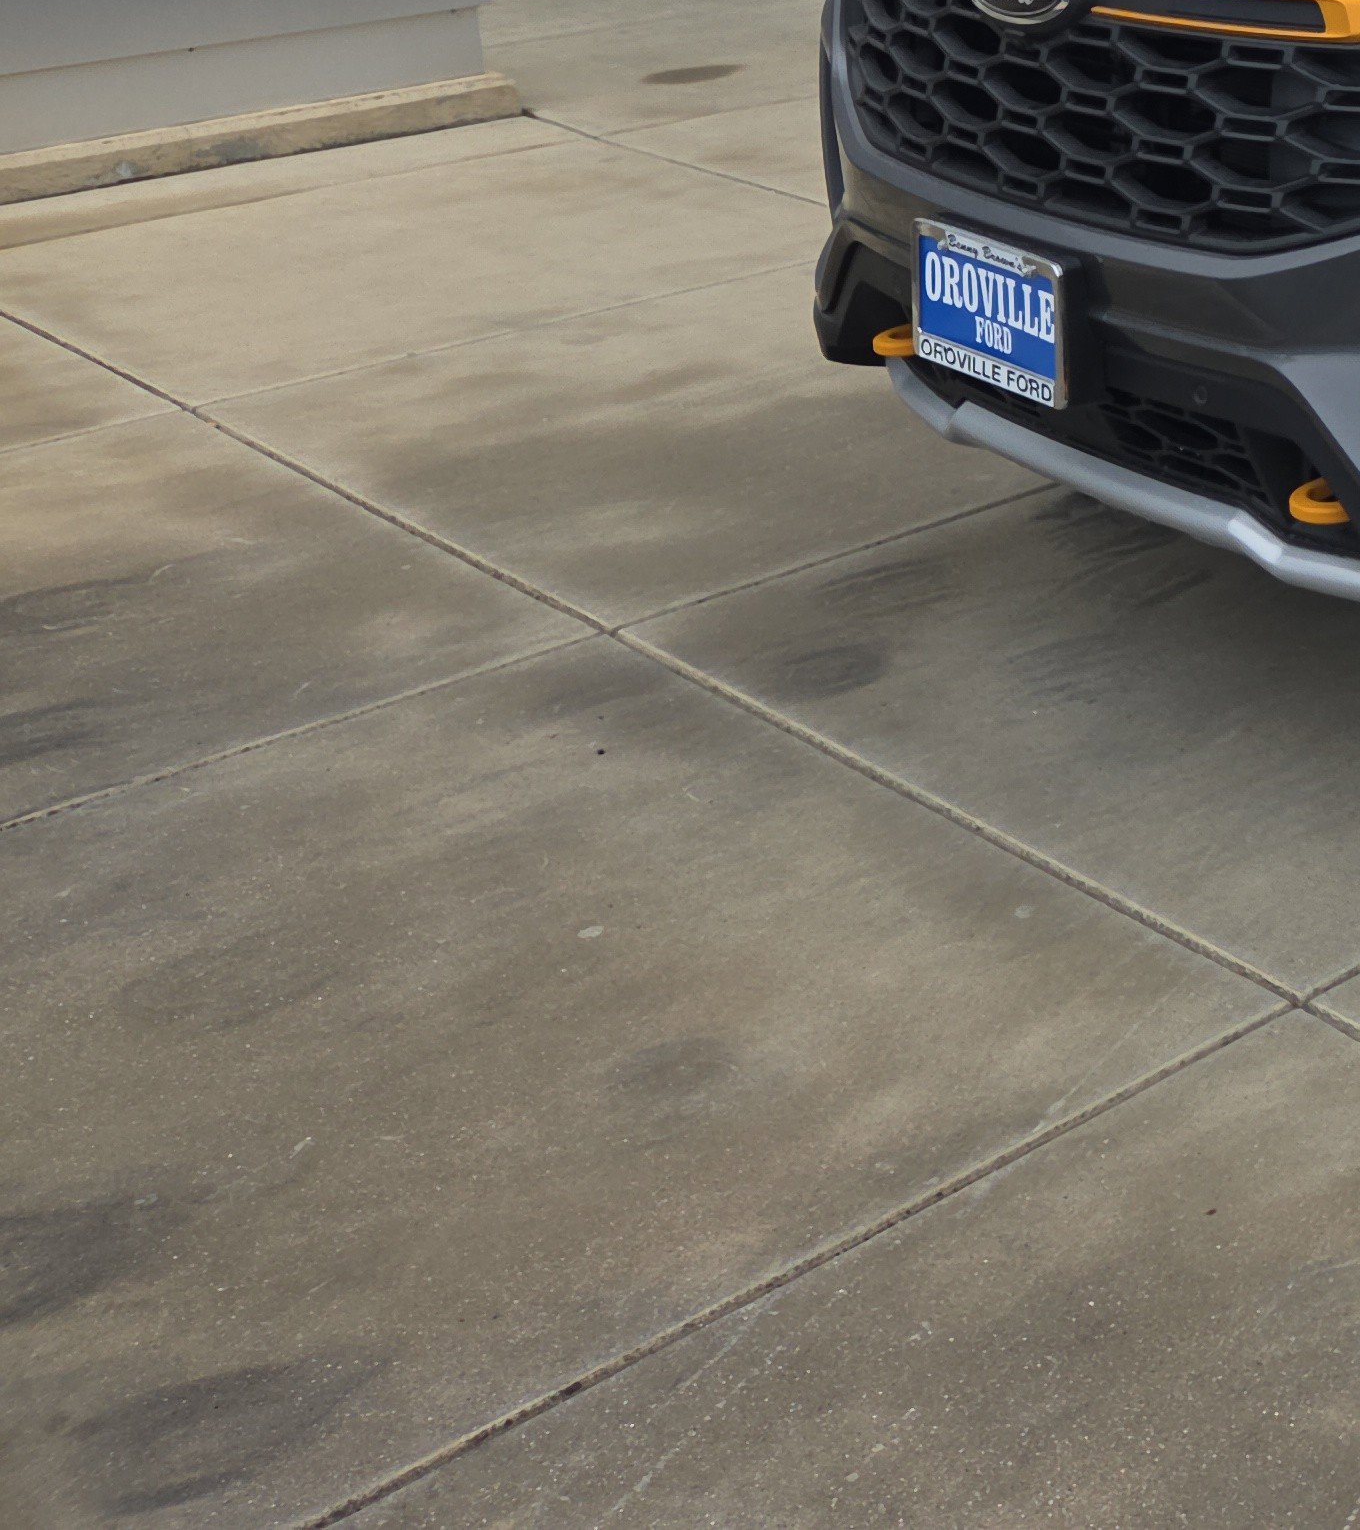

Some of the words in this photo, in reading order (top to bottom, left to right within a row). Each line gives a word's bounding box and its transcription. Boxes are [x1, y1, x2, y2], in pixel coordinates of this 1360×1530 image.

[924, 251, 1055, 344] OROVILLE
[975, 316, 1013, 355] FORD
[920, 338, 1002, 383] OROVILLE
[1006, 373, 1052, 402] FORD
